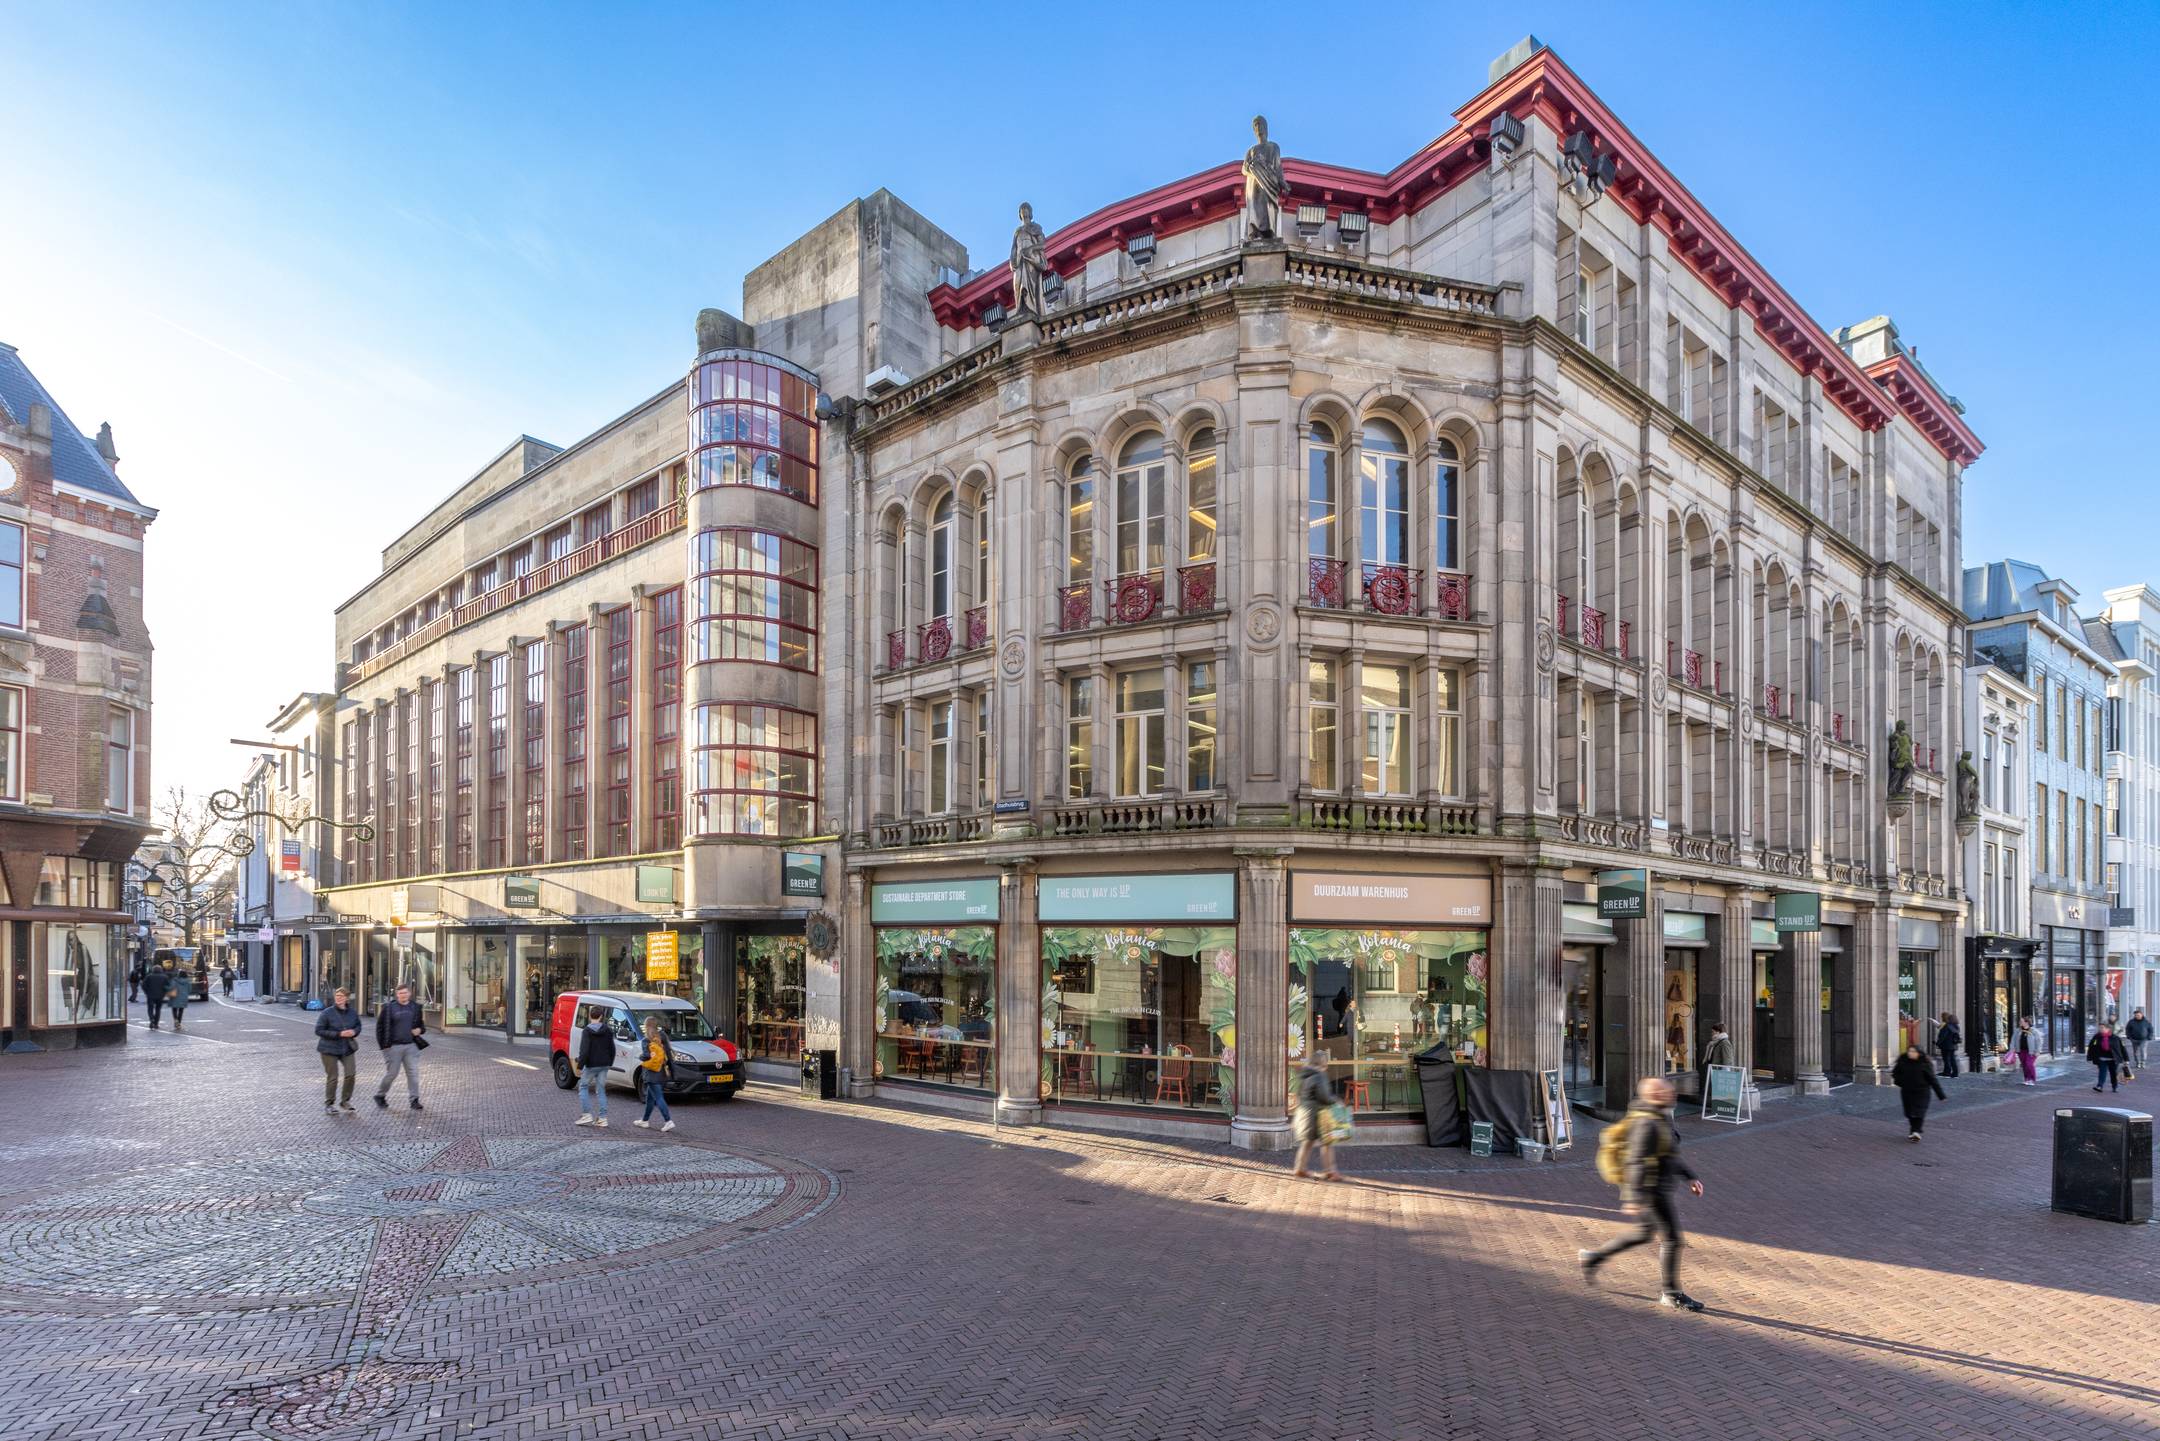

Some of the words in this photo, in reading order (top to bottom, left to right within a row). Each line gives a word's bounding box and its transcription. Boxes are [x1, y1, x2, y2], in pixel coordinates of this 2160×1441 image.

[790, 878, 809, 888] GREEN
[809, 877, 817, 889] UP
[882, 892, 914, 903] SUSTAINABLE
[914, 891, 948, 902] DEPARTMENT
[949, 890, 966, 901] STORE
[1056, 888, 1070, 898] THE
[1071, 888, 1090, 898] ONLY
[1091, 887, 1108, 898] WAY
[1110, 887, 1118, 898] IS
[1119, 884, 1131, 897] UP
[1314, 884, 1359, 897] DUURZAAM
[1360, 886, 1409, 899] WARENHUIS
[510, 895, 528, 903] GREEN
[528, 894, 536, 902] UP
[1603, 899, 1629, 910] GREEN
[1629, 896, 1640, 908] UP
[966, 906, 980, 914] GREEN
[1187, 904, 1208, 913] GREEN
[1208, 902, 1217, 912] UP
[1452, 907, 1472, 916] GREEN
[1472, 905, 1481, 916] UP
[1778, 916, 1803, 926] STAND
[1804, 914, 1815, 926] UP
[918, 933, 952, 950] Botania
[1104, 931, 1158, 951] Botania
[1358, 933, 1412, 953] Botania
